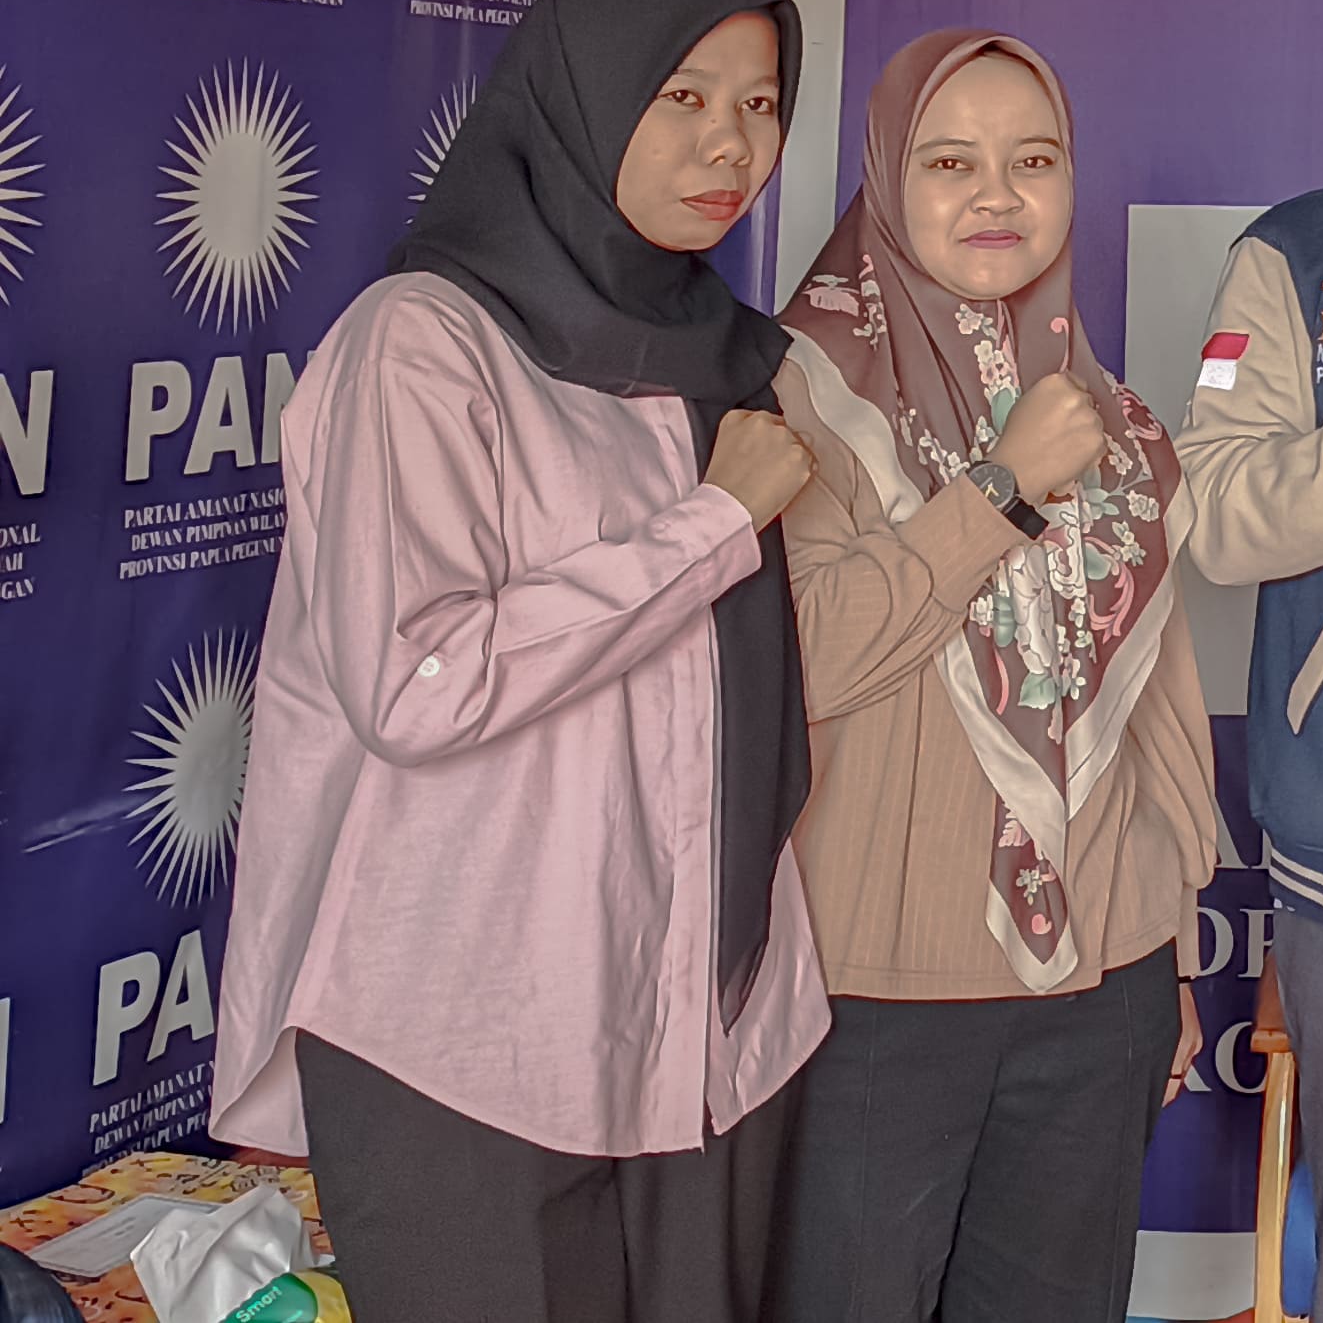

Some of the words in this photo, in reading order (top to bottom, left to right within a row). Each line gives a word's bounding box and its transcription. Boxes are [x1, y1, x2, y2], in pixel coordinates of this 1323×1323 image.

[125, 503, 181, 528] PARTAI
[184, 494, 247, 520] AMANAT
[132, 529, 182, 551] DEWAN
[187, 519, 248, 543] PIMPINAN
[119, 553, 185, 579] PROVINSI
[190, 547, 230, 568] PAPUA
[93, 929, 214, 1086] PA
